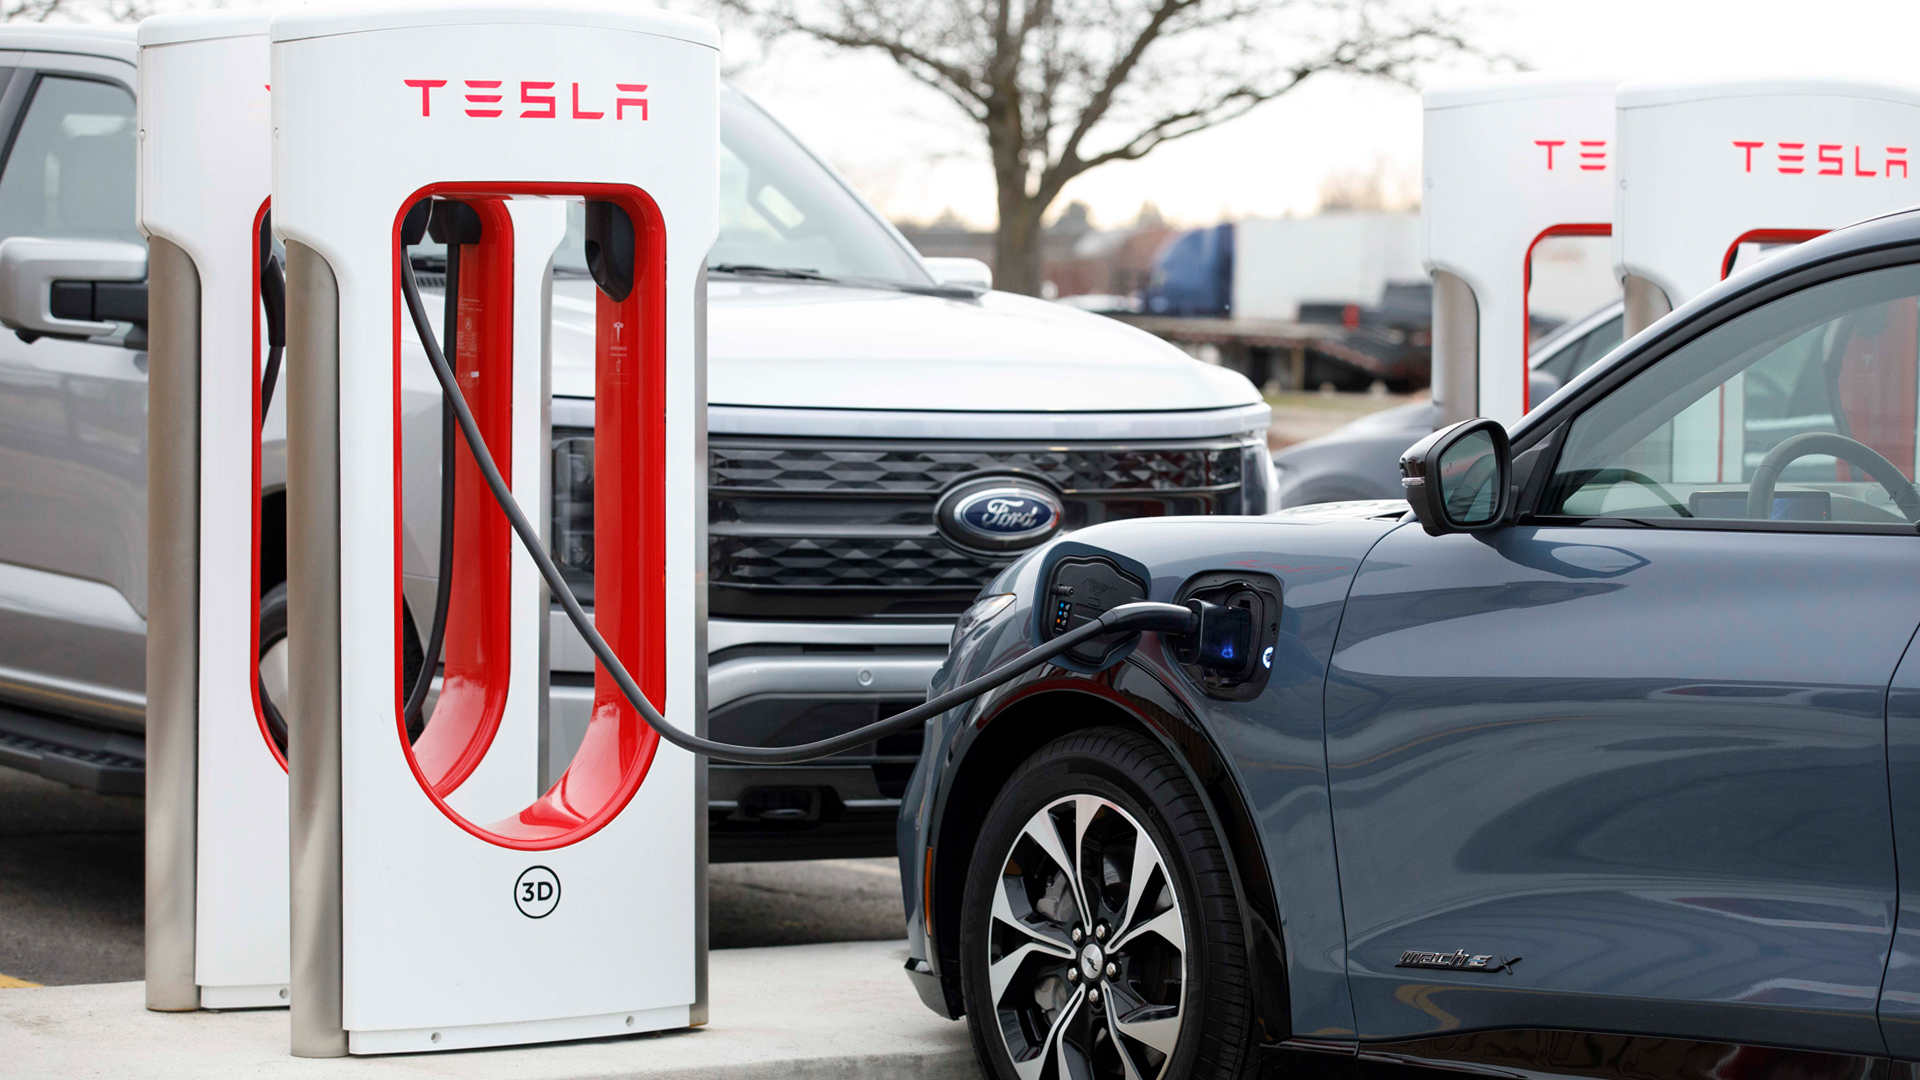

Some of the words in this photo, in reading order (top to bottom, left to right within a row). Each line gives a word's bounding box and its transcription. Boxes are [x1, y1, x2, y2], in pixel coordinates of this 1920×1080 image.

[403, 79, 649, 121] TESLA
[1534, 140, 1606, 171] TE
[1732, 141, 1908, 178] TESLA
[981, 498, 1039, 529] Ford
[521, 881, 554, 903] 3D
